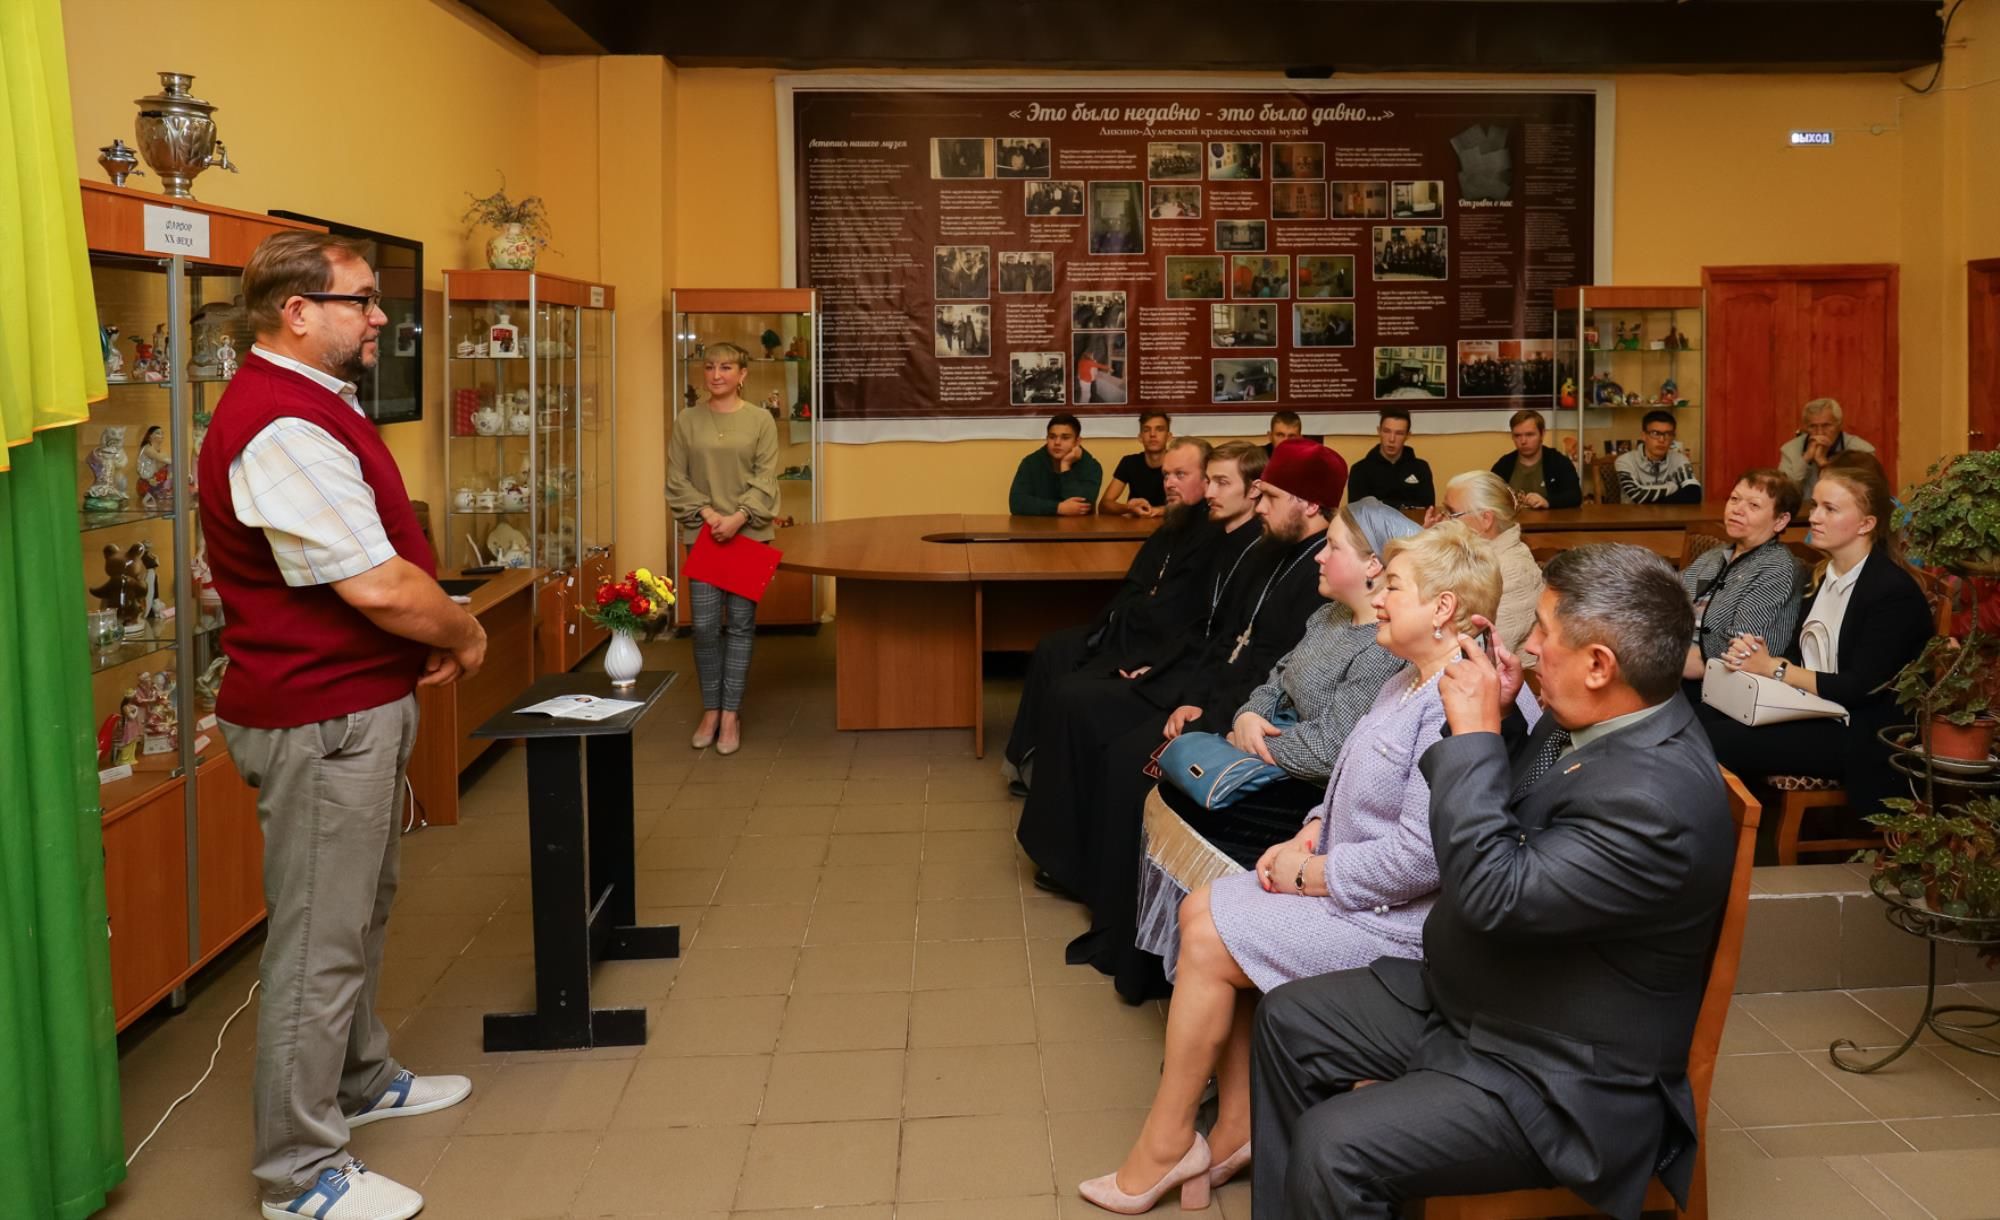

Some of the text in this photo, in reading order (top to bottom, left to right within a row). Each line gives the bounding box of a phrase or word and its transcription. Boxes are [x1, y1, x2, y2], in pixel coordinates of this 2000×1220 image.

[1027, 102, 1067, 122] Это
[1072, 102, 1120, 122] было
[1124, 102, 1200, 126] недавно
[1217, 107, 1255, 122] это
[1259, 103, 1307, 122] было
[1099, 127, 1309, 138] Ликино-Дулевский краеведческий музей
